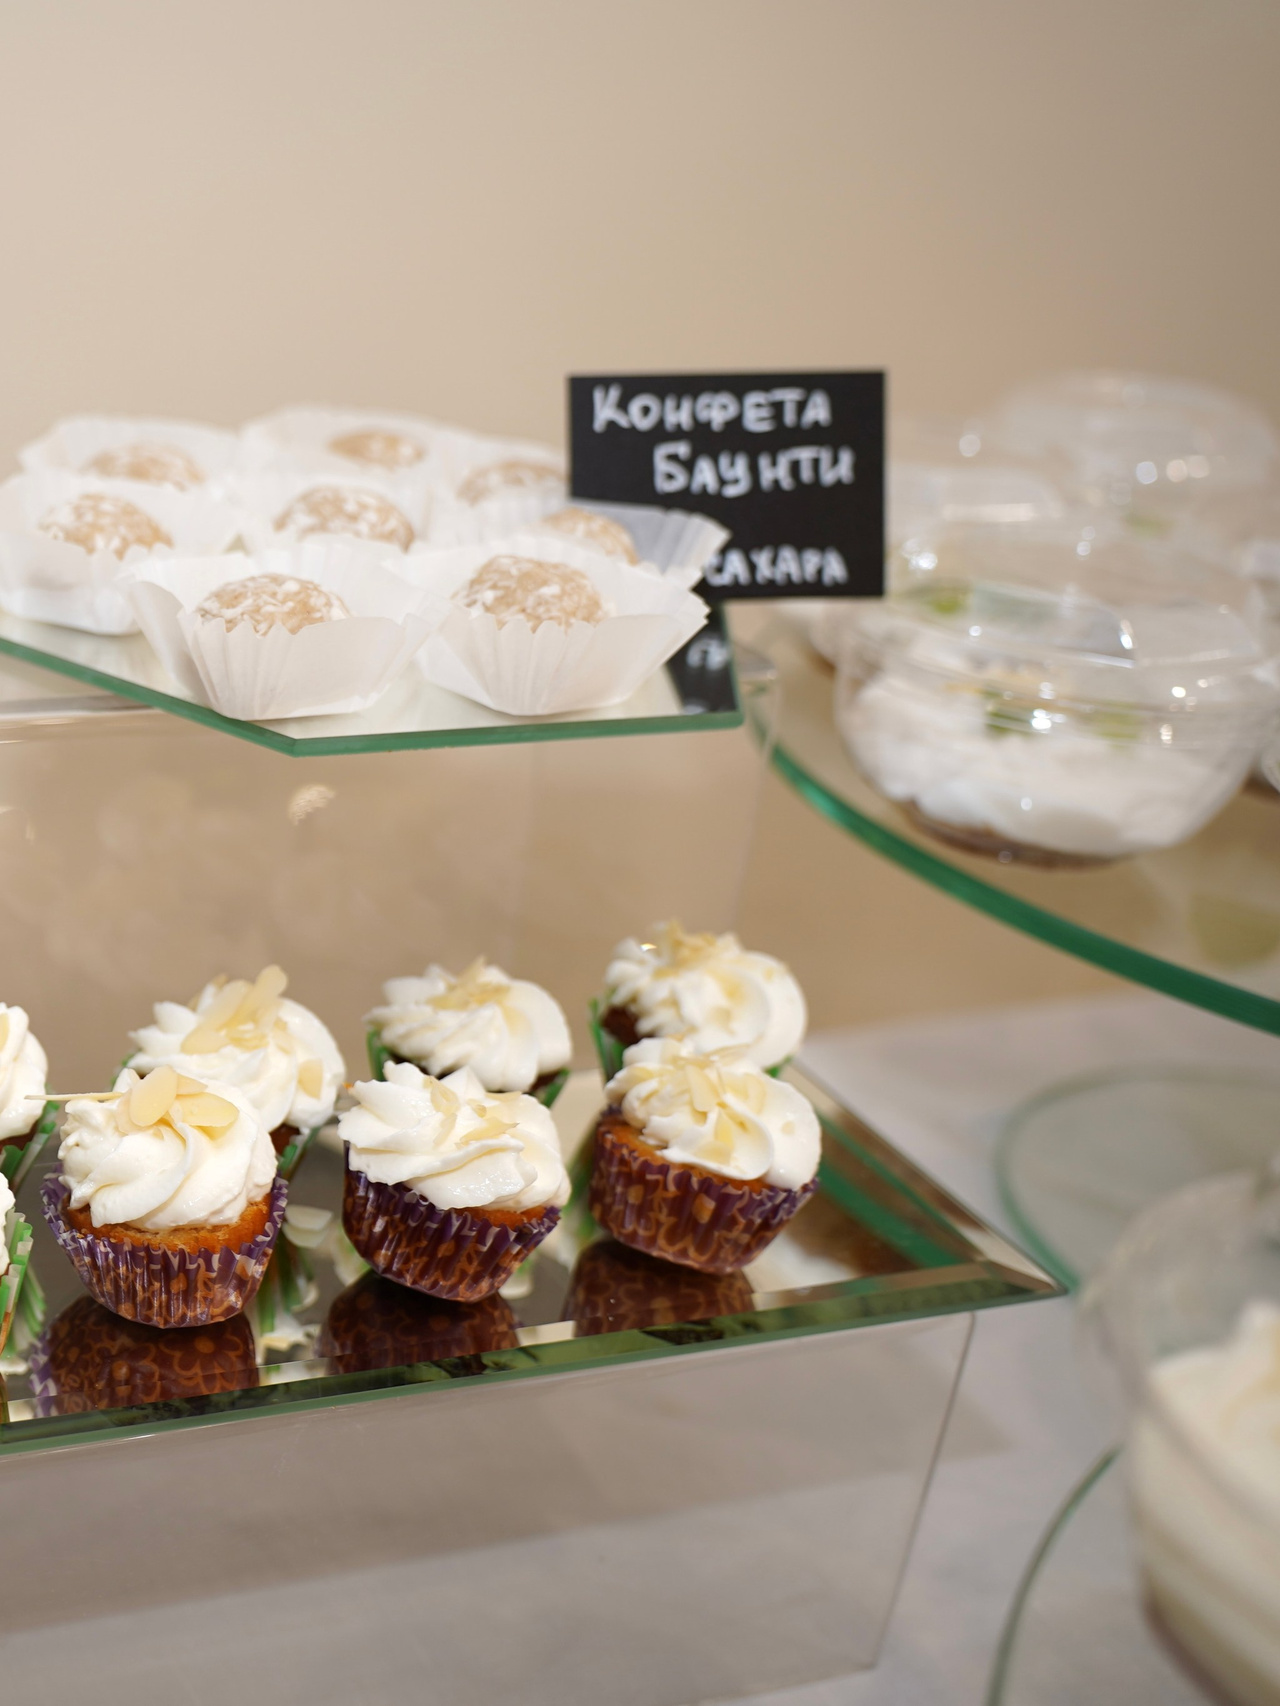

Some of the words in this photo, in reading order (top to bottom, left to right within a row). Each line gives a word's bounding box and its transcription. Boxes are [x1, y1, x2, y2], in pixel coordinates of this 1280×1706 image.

[592, 384, 831, 433] КОНФЕТА
[652, 440, 855, 498] БАУНТИ
[703, 546, 848, 587] САХАРА
